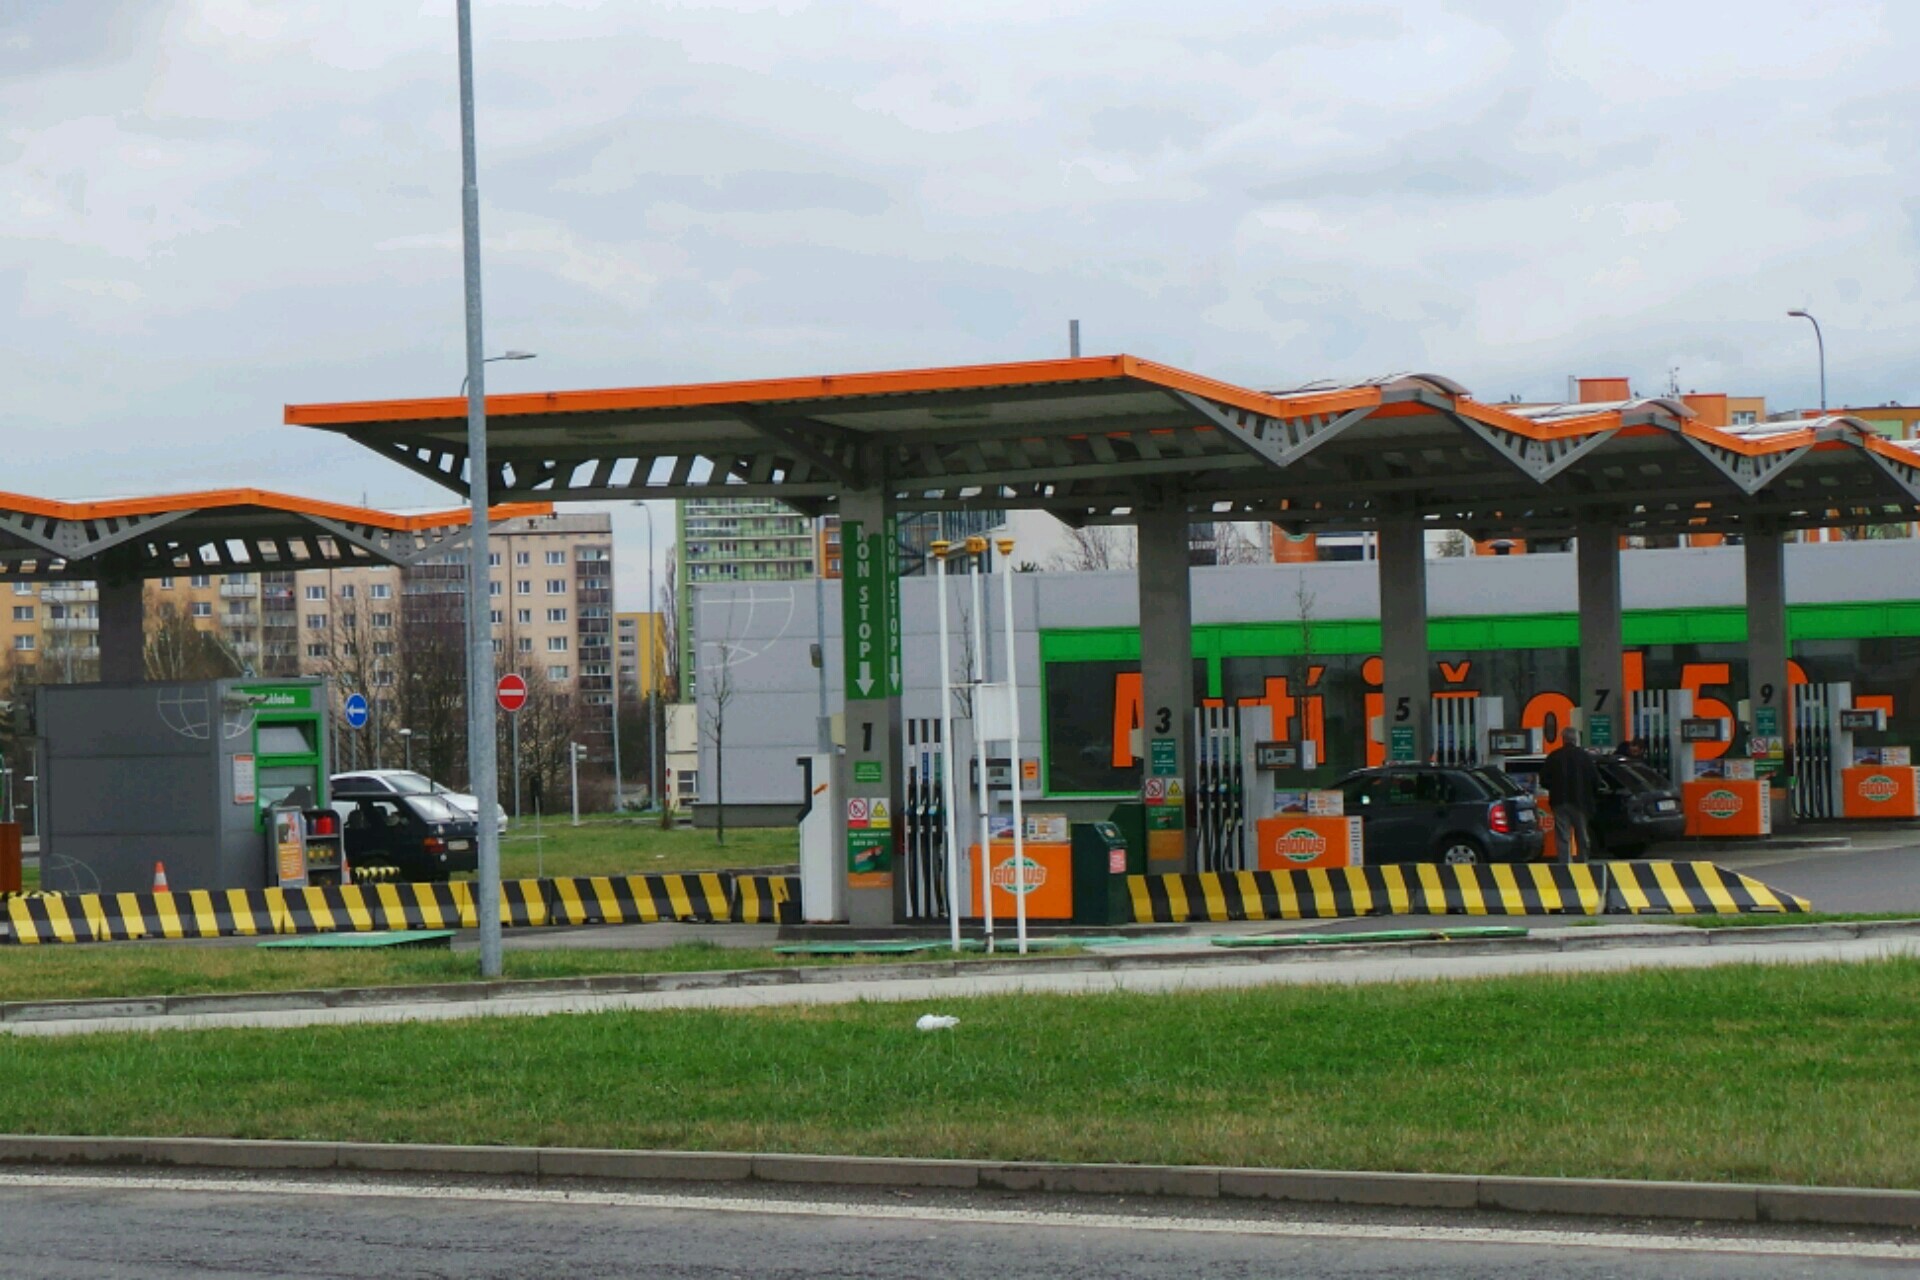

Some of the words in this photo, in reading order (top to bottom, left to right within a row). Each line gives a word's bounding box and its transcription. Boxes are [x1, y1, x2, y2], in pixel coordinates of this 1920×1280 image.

[858, 586, 872, 659] STOP
[889, 581, 898, 653] STOP
[1593, 688, 1611, 712] 7
[1760, 683, 1773, 704] 9
[1154, 706, 1173, 734] 3
[1394, 696, 1411, 722] 5
[862, 722, 873, 752] 1
